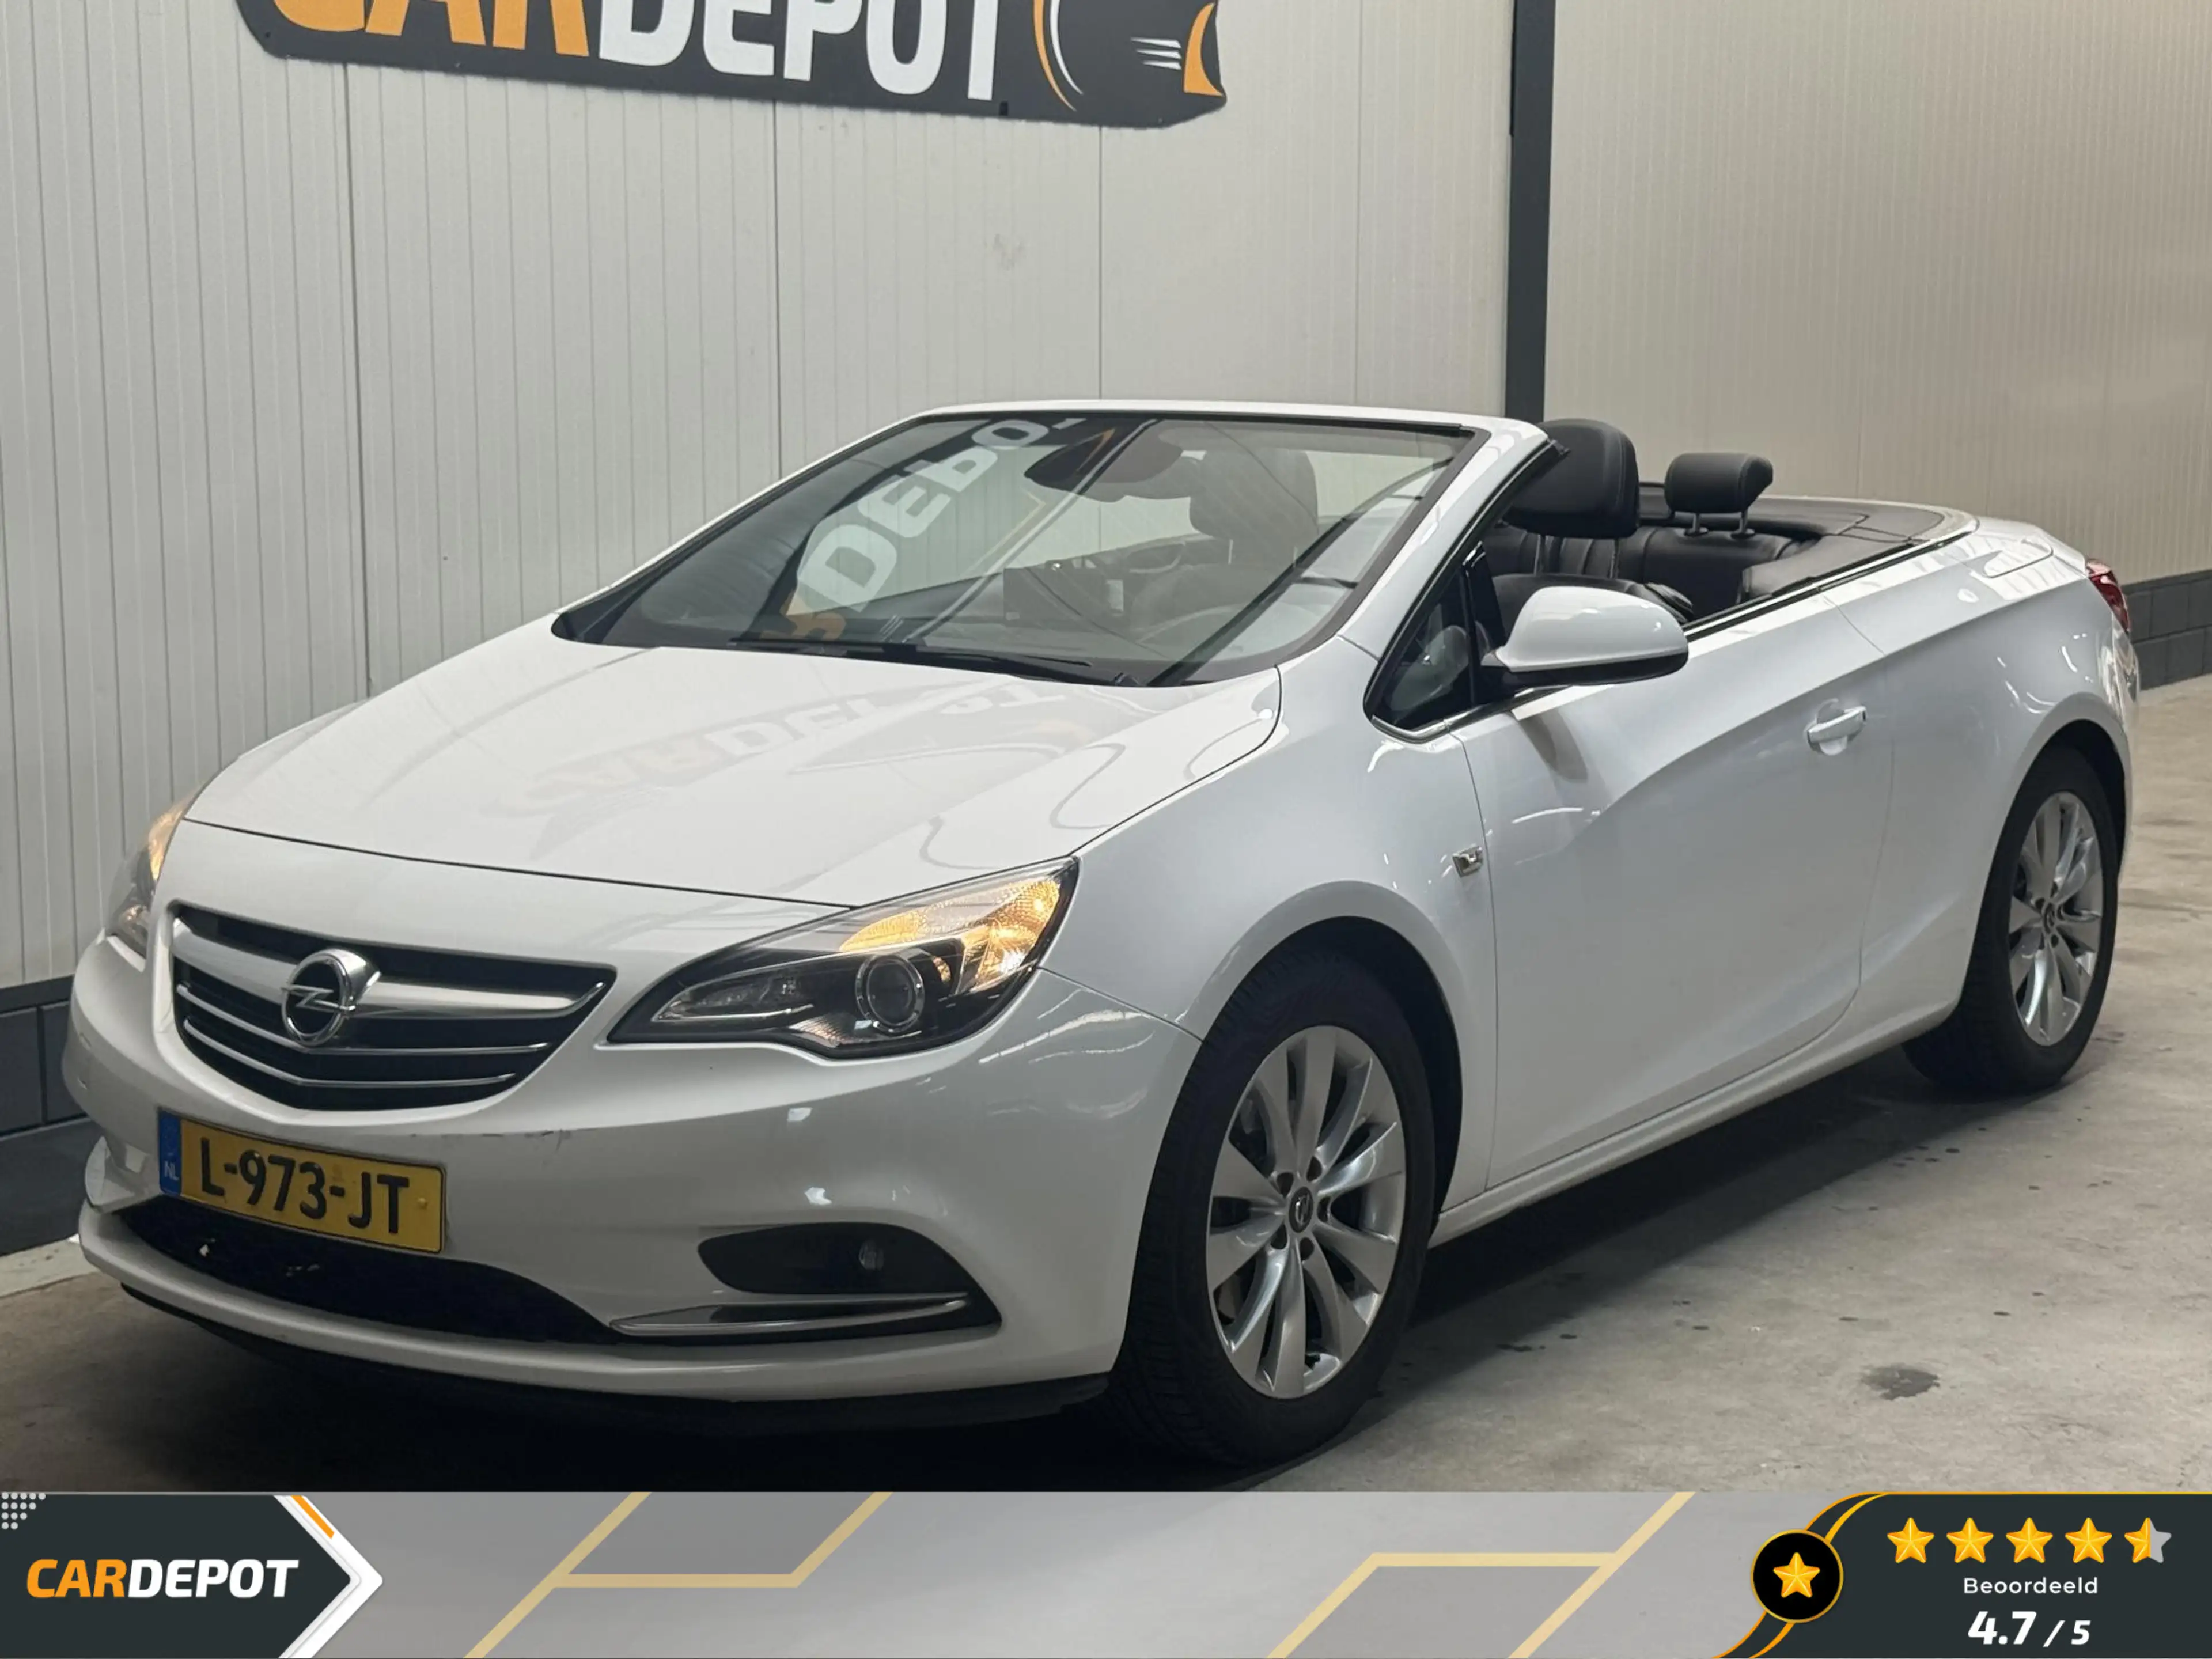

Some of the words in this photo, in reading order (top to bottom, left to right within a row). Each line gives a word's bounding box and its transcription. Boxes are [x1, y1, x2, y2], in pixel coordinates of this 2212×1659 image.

[273, 0, 998, 100] DEPOT
[164, 1160, 180, 1181] NL
[200, 1137, 410, 1234] L-973-JT
